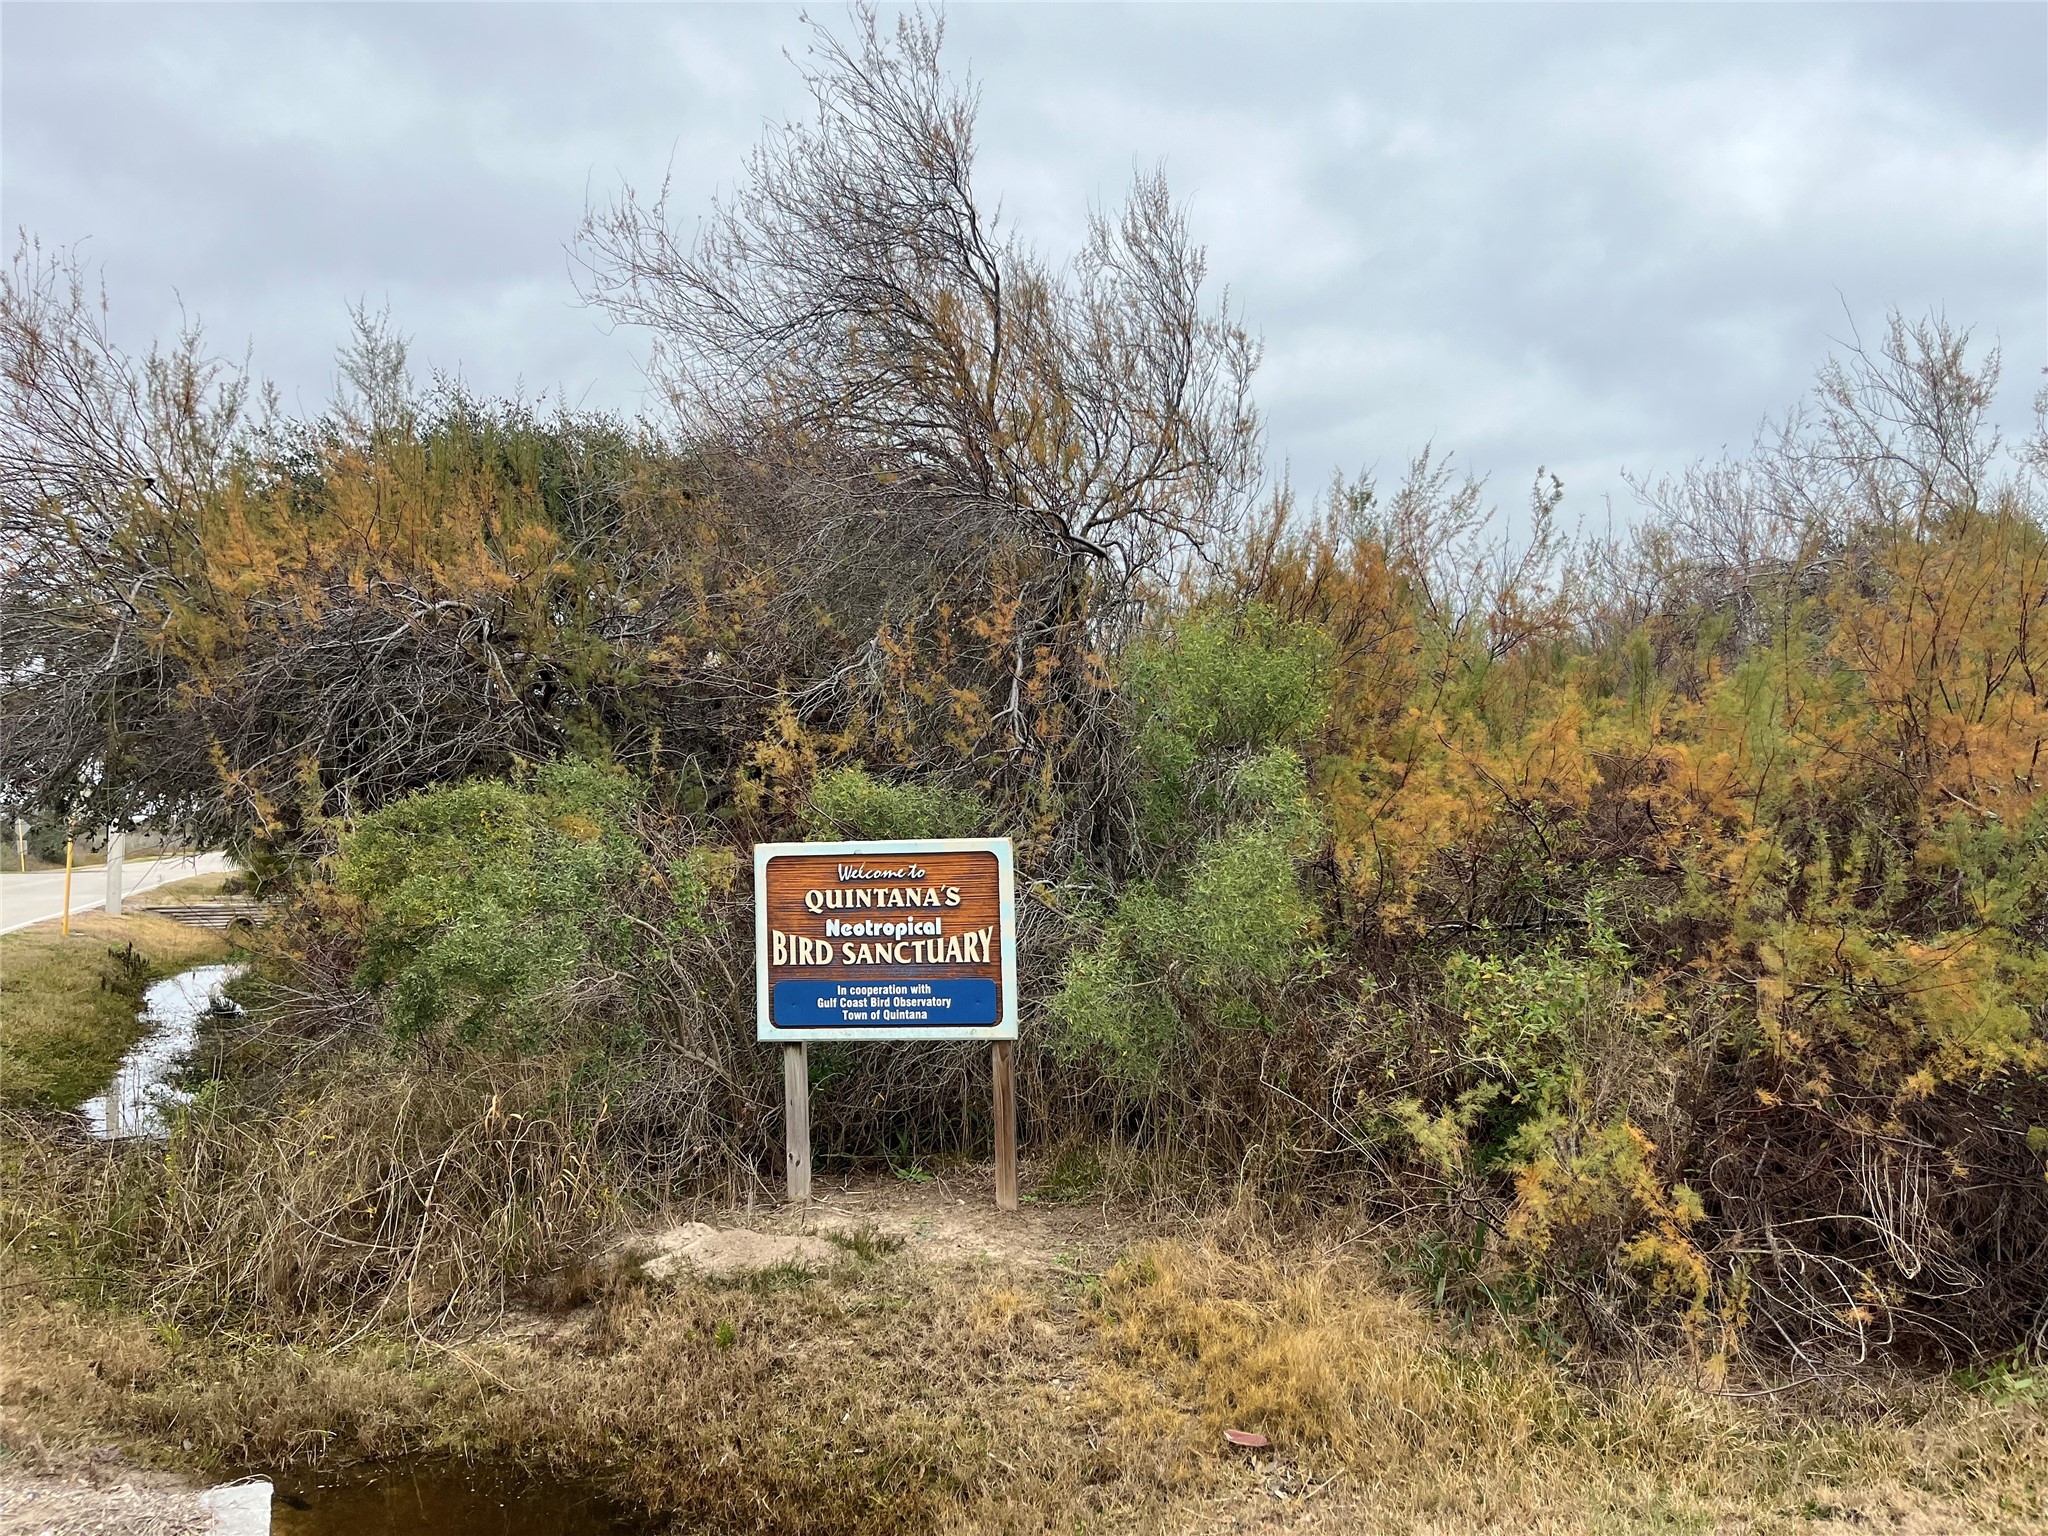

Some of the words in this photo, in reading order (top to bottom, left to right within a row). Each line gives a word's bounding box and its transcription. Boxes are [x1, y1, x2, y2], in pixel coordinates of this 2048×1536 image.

[838, 862, 905, 881] Welcome
[908, 864, 925, 879] to
[805, 885, 961, 914] QUINTANA'S
[826, 917, 941, 940] Neotropical
[773, 930, 833, 966] BIRD
[842, 926, 994, 965] SANCTUARY
[838, 985, 847, 995] In
[850, 985, 908, 997] cooperation
[911, 984, 931, 994] with
[817, 998, 837, 1008] Gulf
[840, 998, 867, 1008] Coast
[871, 998, 890, 1007] Bird
[893, 998, 951, 1009] Observatory
[842, 1010, 867, 1020] Town
[871, 1010, 880, 1020] of
[883, 1010, 927, 1020] Quintana
